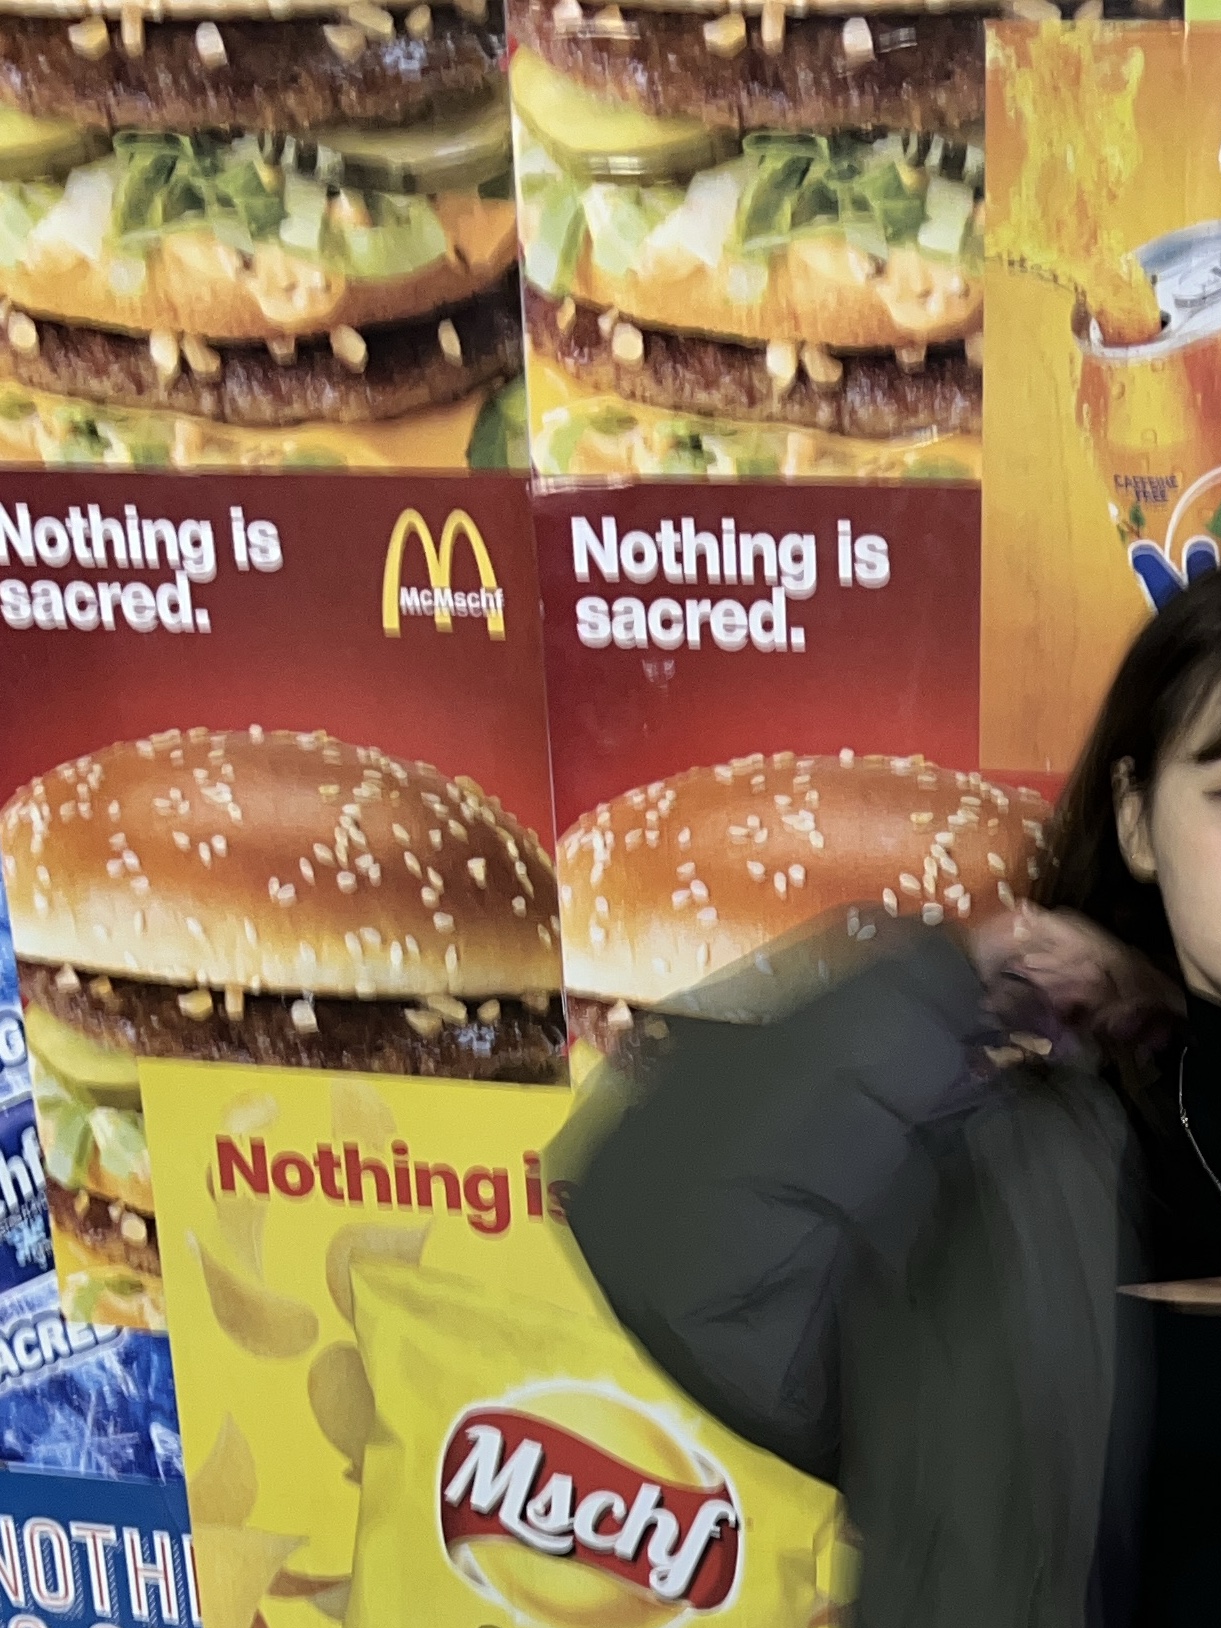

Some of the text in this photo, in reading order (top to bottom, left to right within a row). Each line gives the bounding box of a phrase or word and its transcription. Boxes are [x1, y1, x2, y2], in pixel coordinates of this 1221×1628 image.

[0, 502, 284, 583] Nothing is
[571, 515, 891, 600] Nothing is
[0, 568, 212, 634] sacred.
[400, 586, 504, 617] McMschf
[575, 585, 806, 652] sacred.
[215, 1134, 511, 1239] Nothing
[444, 1424, 739, 1599] Mschf
